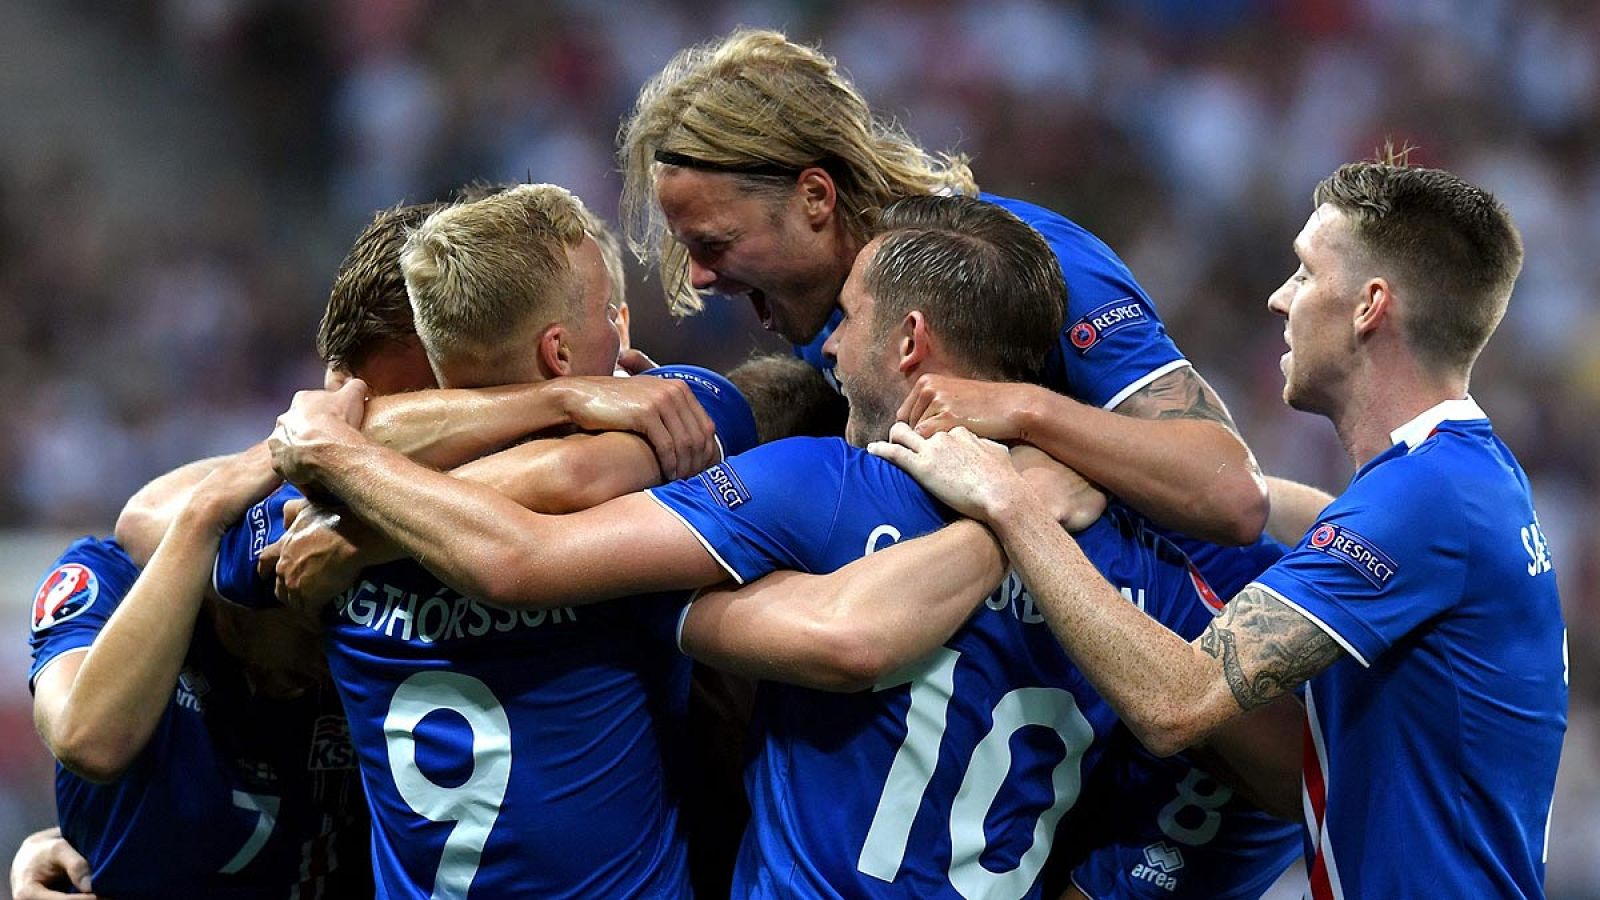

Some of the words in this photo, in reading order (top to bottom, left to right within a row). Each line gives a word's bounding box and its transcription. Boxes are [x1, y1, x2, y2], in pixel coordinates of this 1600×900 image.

[1092, 303, 1144, 331] RESPECT
[1332, 535, 1394, 582] RESPECT
[383, 670, 512, 900] 9
[858, 647, 1095, 900] 10
[1157, 767, 1233, 846] 8
[216, 789, 282, 876] 7
